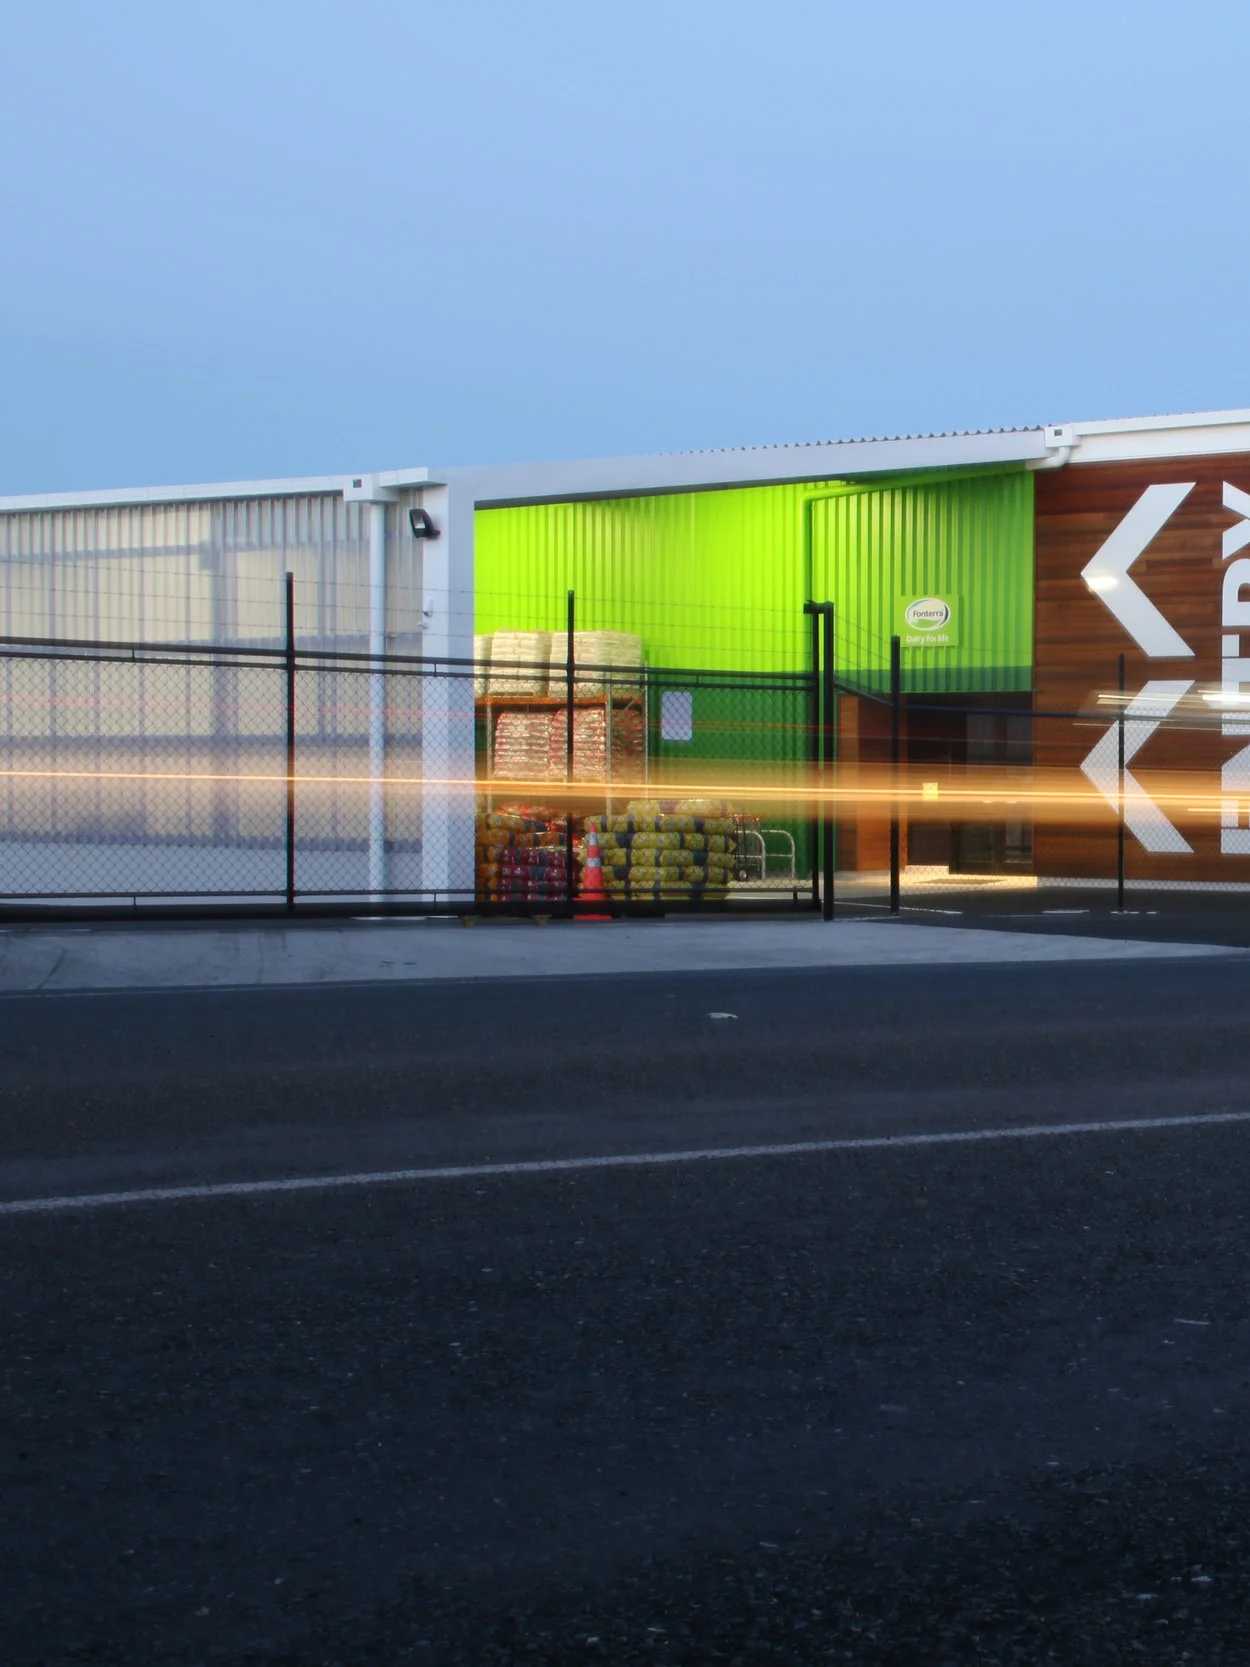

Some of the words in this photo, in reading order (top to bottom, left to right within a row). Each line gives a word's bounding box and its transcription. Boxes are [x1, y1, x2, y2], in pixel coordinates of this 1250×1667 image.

[912, 609, 944, 618] Fonterra
[906, 634, 924, 645] Dairy
[926, 634, 937, 643] for
[938, 633, 949, 643] life
